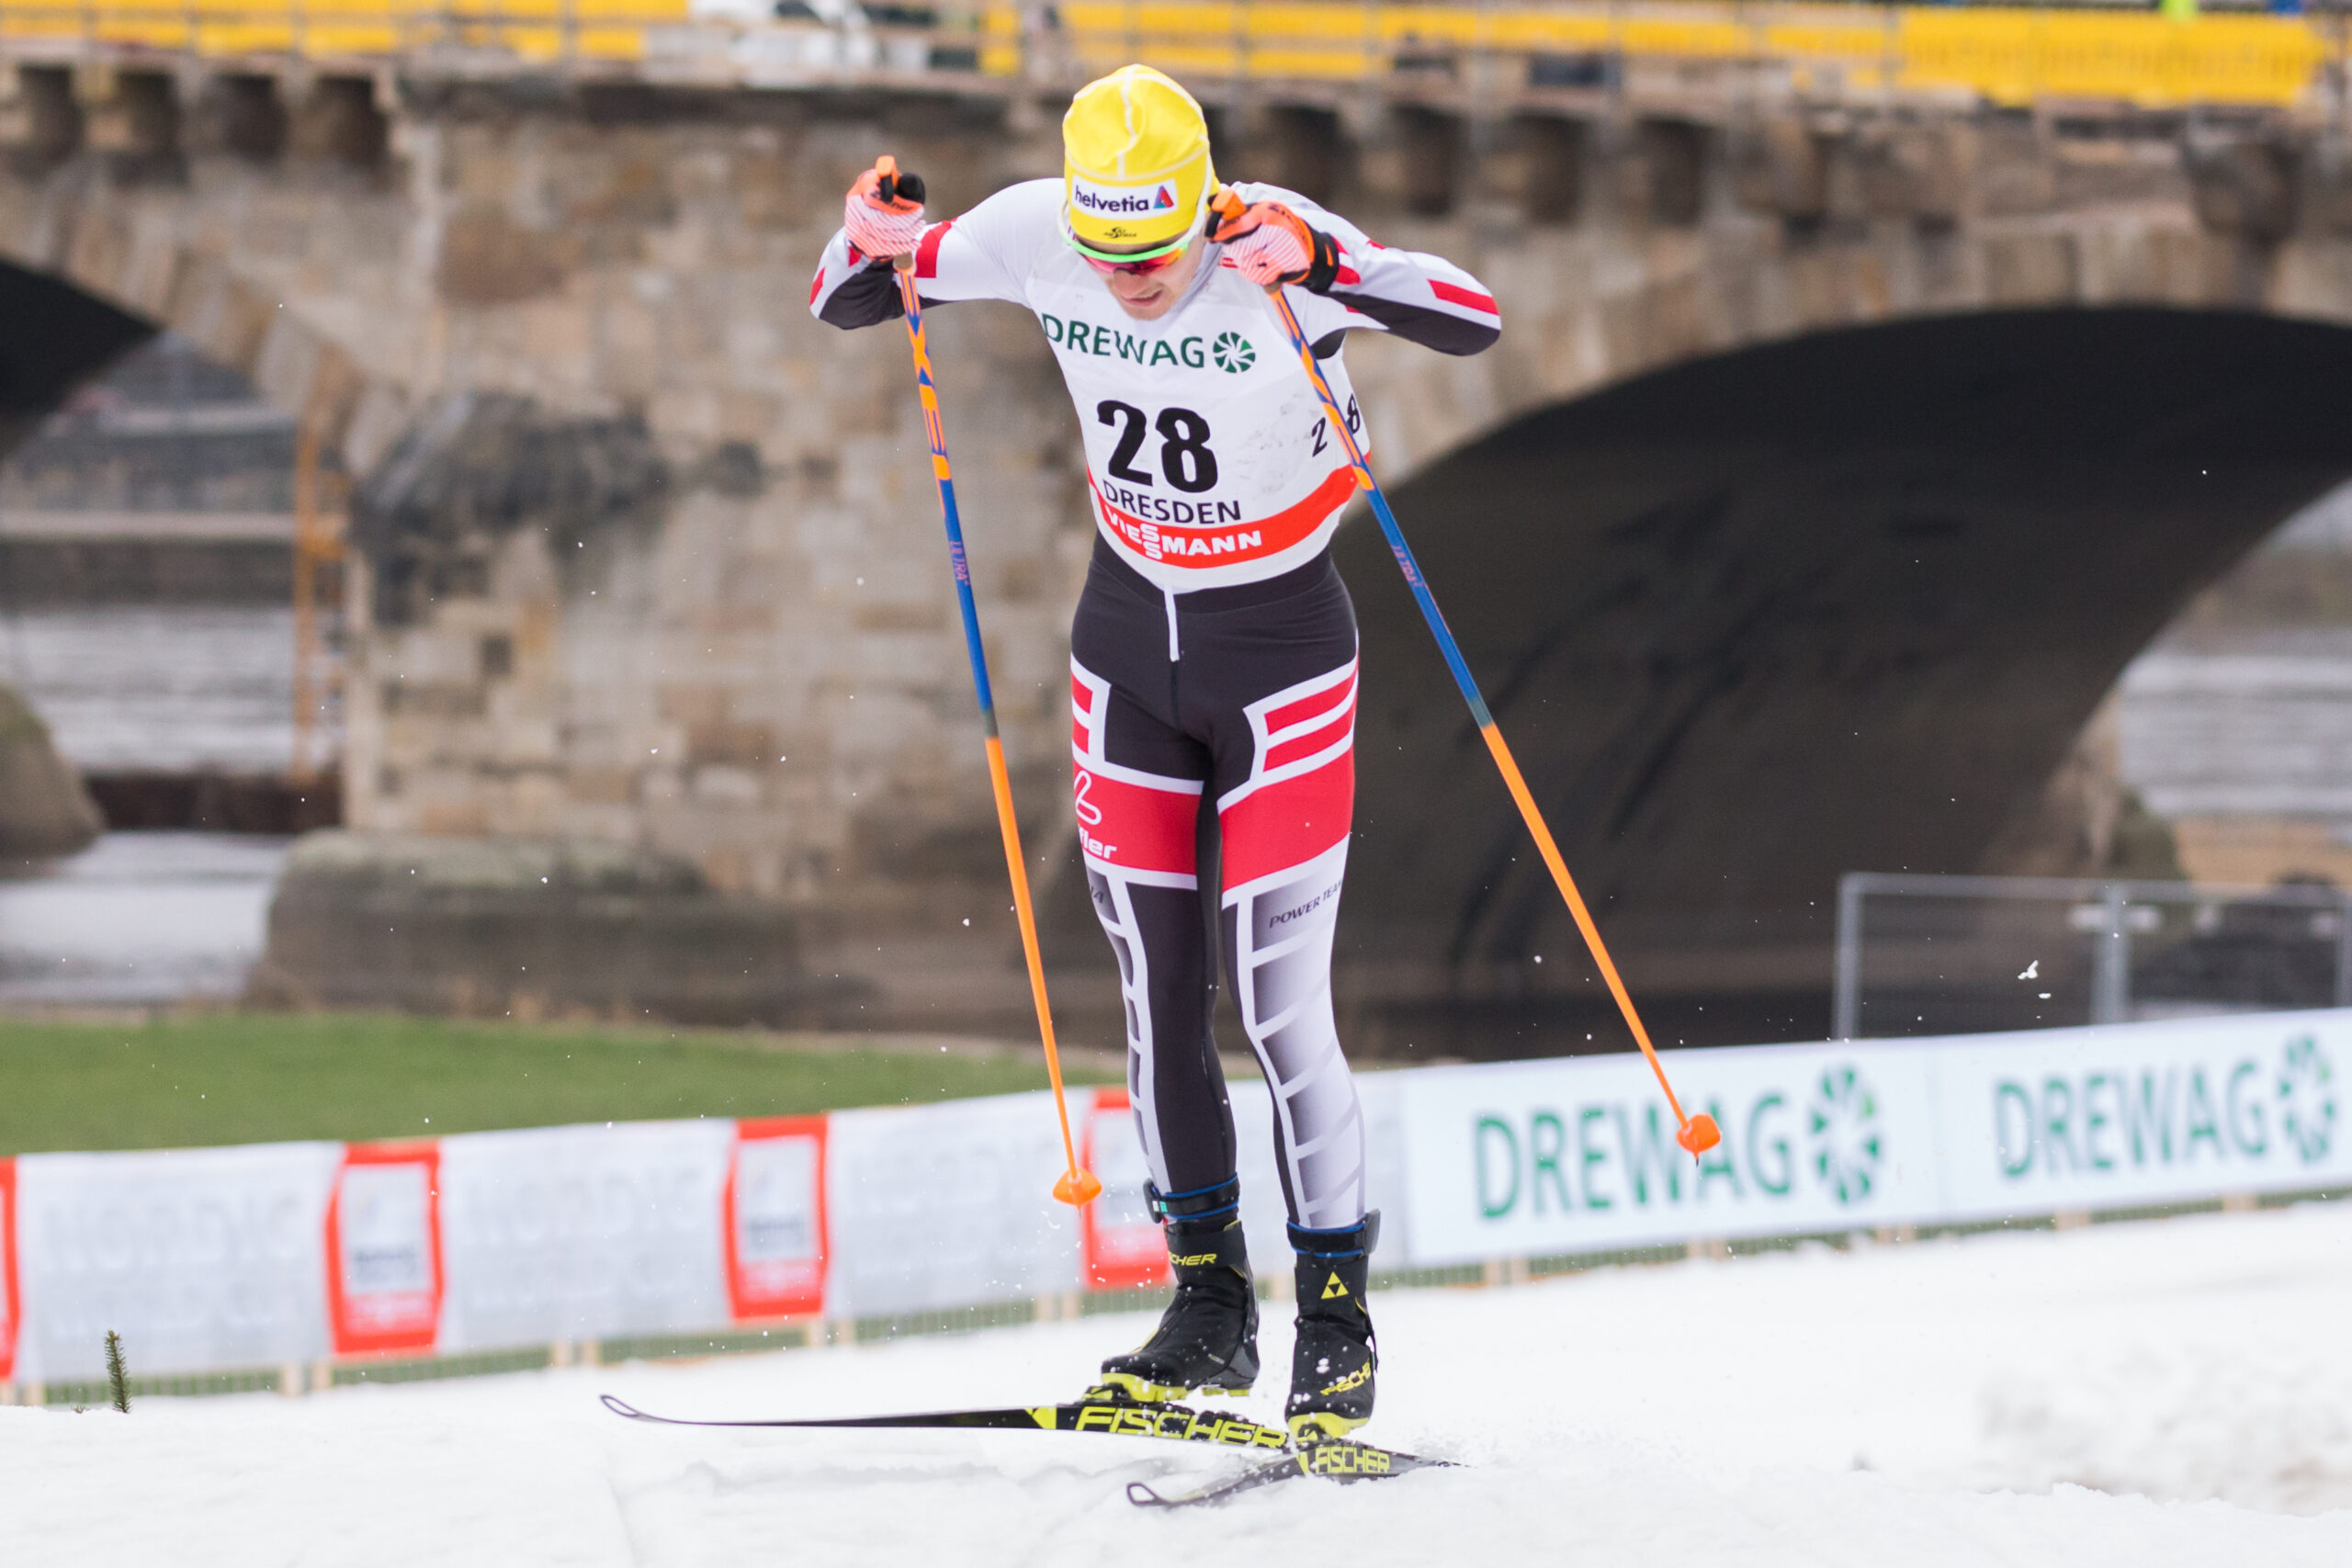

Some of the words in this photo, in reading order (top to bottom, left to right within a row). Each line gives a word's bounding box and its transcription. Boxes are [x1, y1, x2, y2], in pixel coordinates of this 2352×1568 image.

[1075, 185, 1149, 212] helvetia
[1042, 313, 1204, 368] DREWAG
[1097, 400, 1218, 493] 28
[1102, 479, 1241, 525] DRESDEN
[1104, 504, 1262, 559] VIESSMANN
[1269, 896, 1320, 929] POWER
[1993, 1060, 2267, 1179] DREWAG
[1476, 1093, 1794, 1220] DREWAG
[1075, 1405, 1287, 1449] FISCHER
[1315, 1447, 1390, 1474] FISCHER
